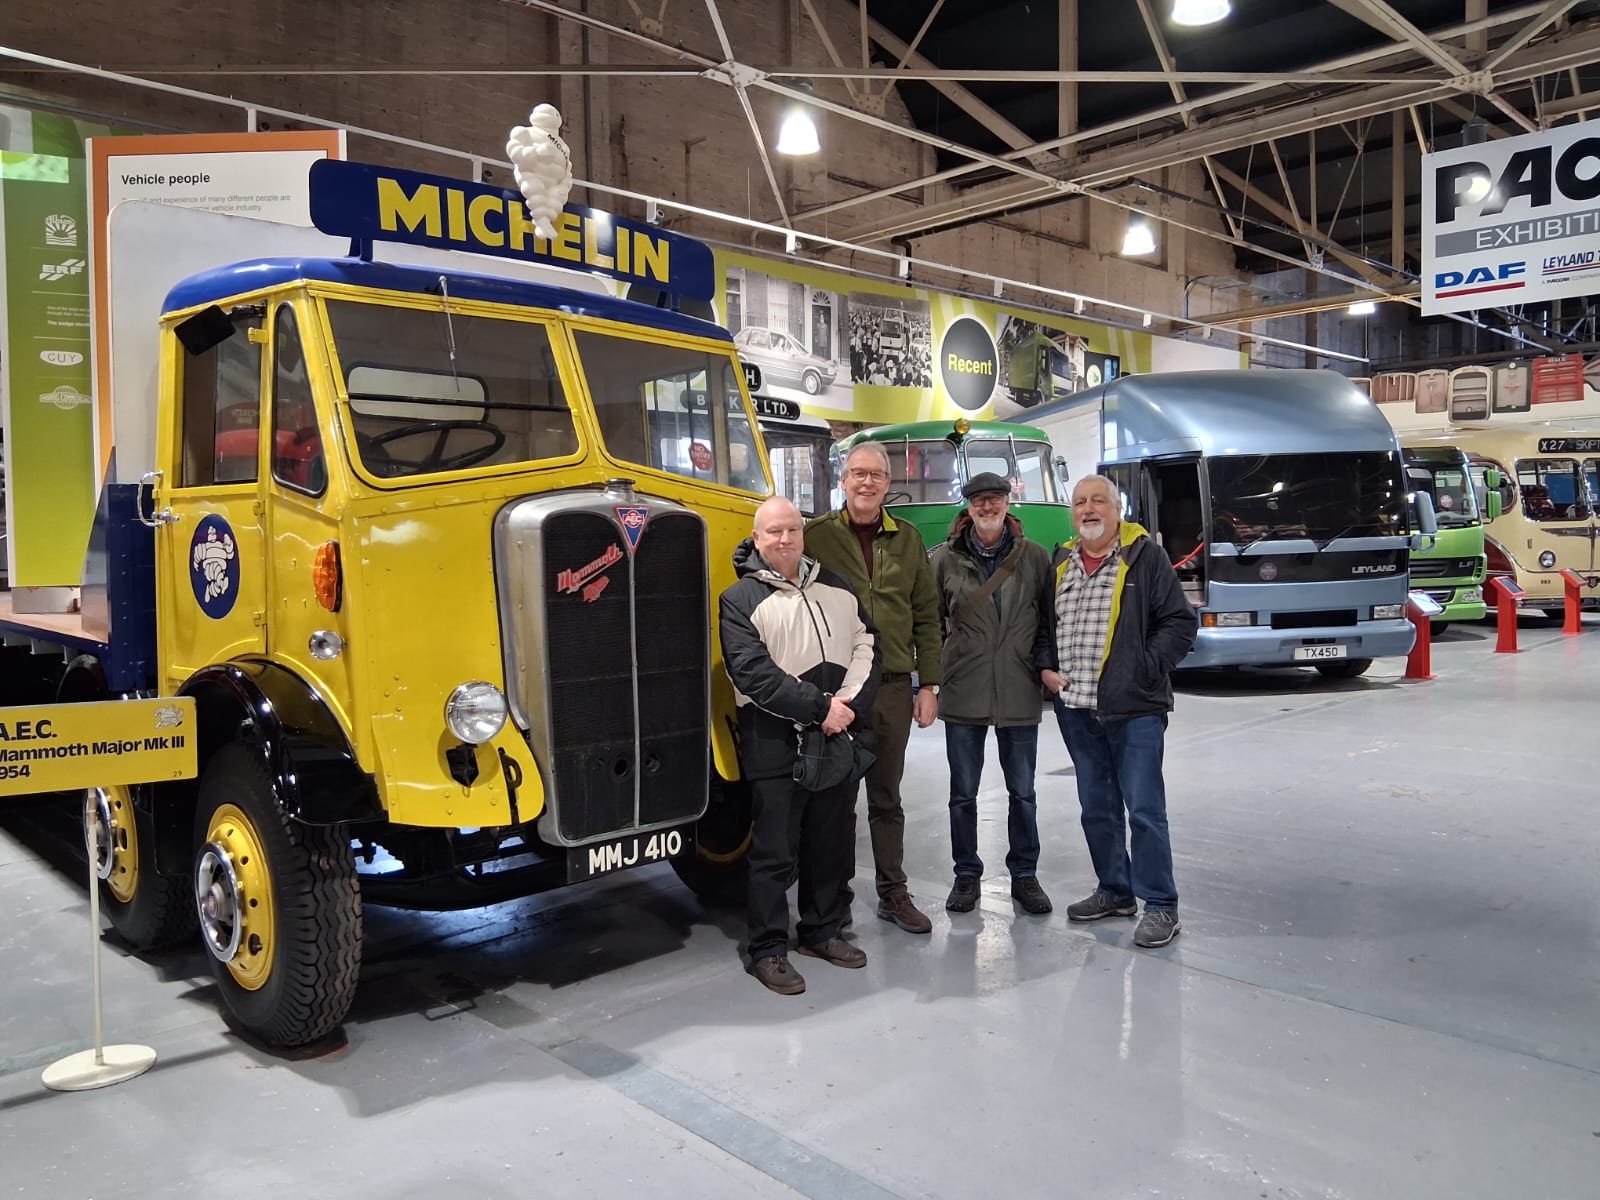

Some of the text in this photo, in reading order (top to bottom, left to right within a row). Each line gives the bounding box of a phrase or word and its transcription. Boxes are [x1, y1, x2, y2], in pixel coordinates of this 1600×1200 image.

[121, 172, 211, 186] Vehicle people
[208, 196, 226, 204] many
[227, 195, 254, 203] different
[255, 194, 279, 203] people
[211, 204, 234, 212] vehicle
[235, 204, 262, 213] industry
[377, 177, 670, 283] MICHELIN
[1543, 250, 1595, 269] LEYLAND
[1435, 261, 1526, 289] DAF
[948, 353, 993, 376] Recent
[763, 400, 790, 416] LTD.
[624, 514, 643, 523] AEC
[1351, 564, 1397, 574] LEYLAND
[1303, 647, 1338, 657] TX450
[92, 740, 143, 756] Major
[144, 737, 169, 750] Mk
[588, 831, 683, 876] MMJ 410
